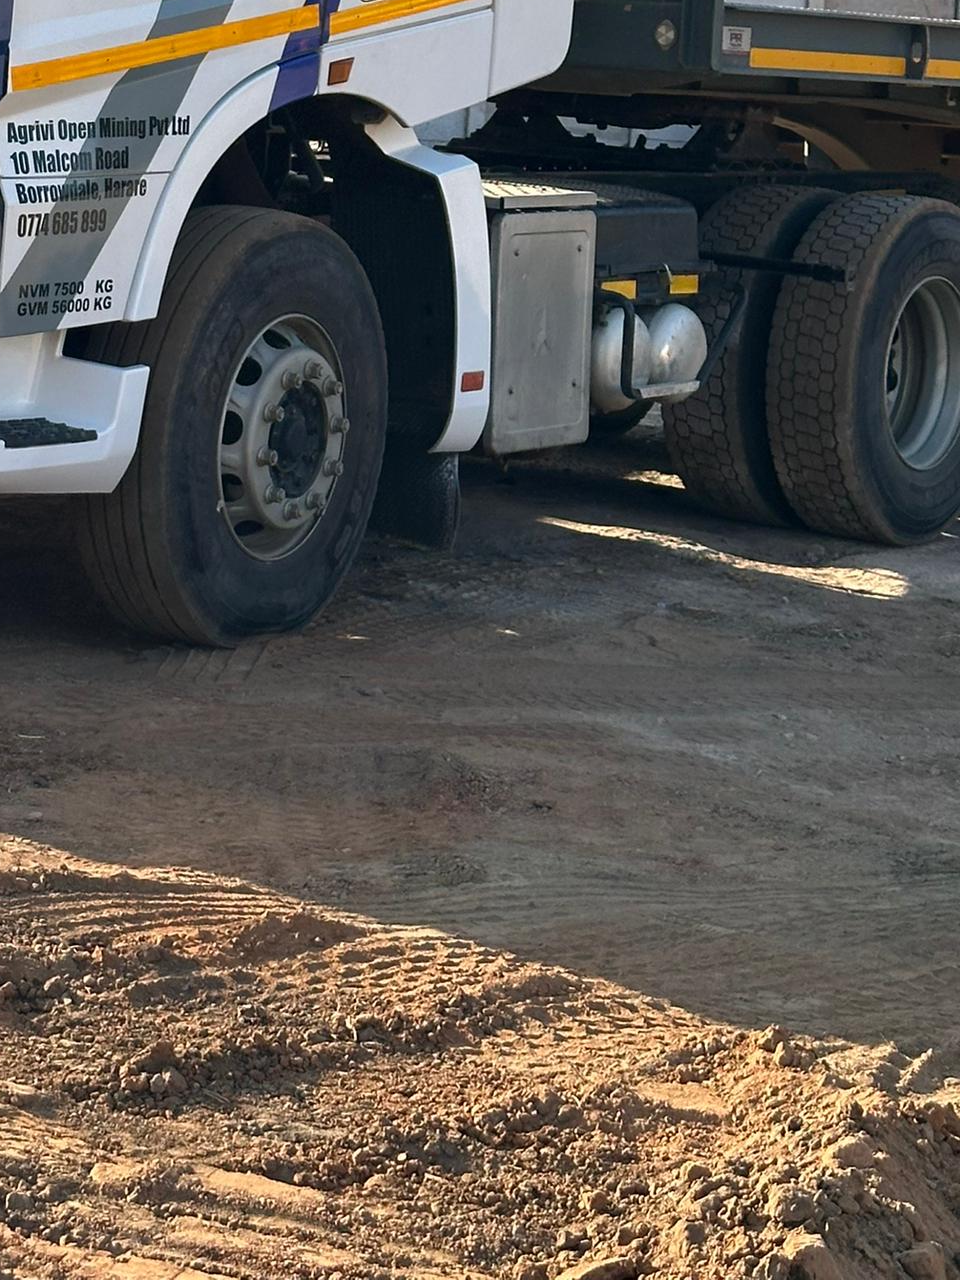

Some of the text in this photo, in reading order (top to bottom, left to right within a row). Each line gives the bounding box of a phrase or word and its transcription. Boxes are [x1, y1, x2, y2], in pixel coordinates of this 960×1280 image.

[7, 115, 190, 145] Agrivi Open Mining Pvt Ltd
[10, 146, 129, 174] 10 Malcom Road
[104, 178, 147, 200] Harare
[17, 209, 107, 237] 0774 685 899
[19, 279, 114, 298] NVM 7500 KG
[17, 296, 112, 316] GVM 56000 KG
